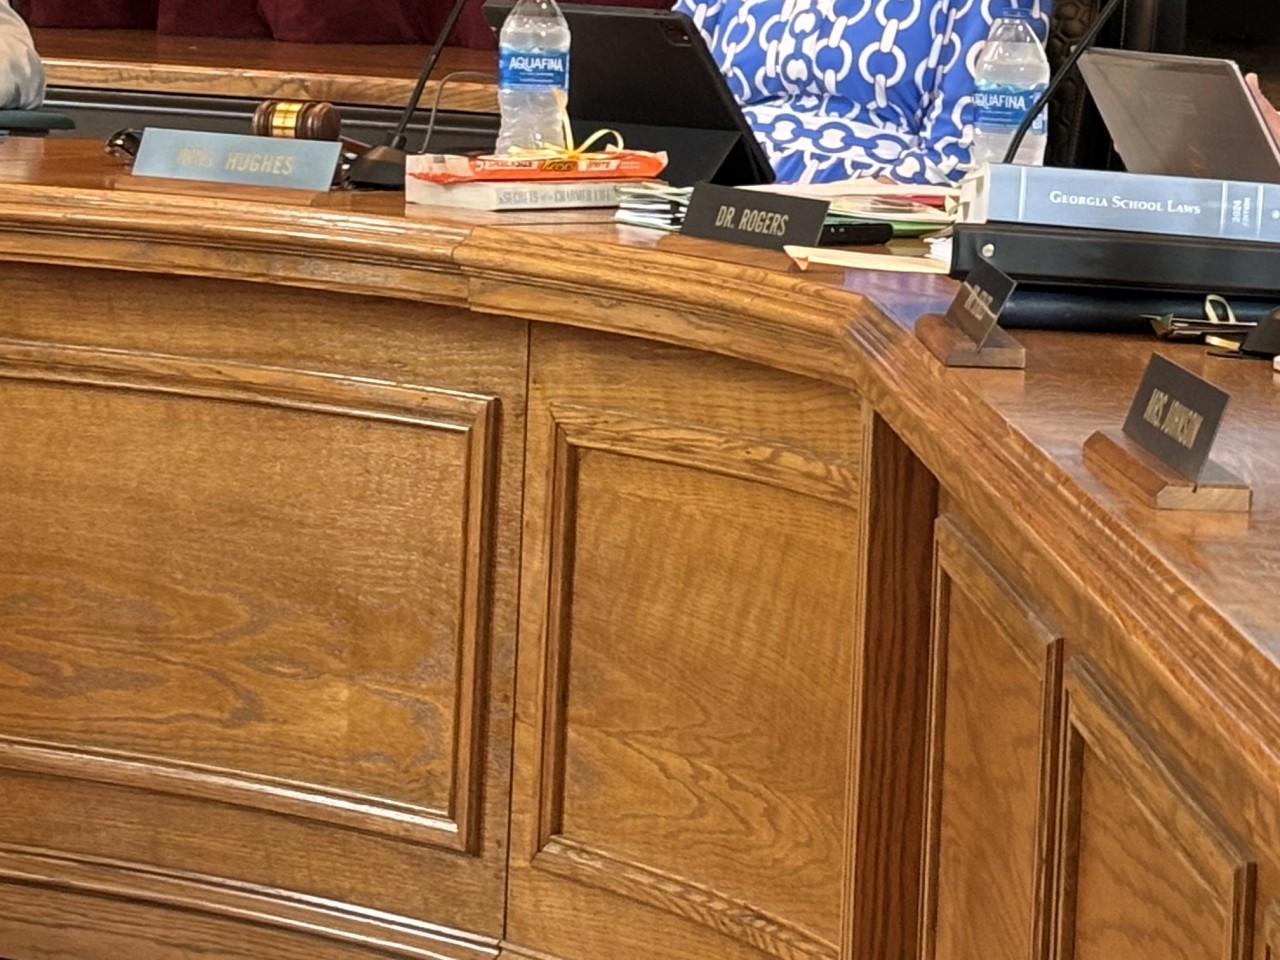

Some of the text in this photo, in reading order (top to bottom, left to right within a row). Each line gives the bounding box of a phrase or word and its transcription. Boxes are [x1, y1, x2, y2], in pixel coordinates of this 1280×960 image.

[508, 56, 564, 72] AQUAFINA
[224, 150, 297, 177] HUGHES
[1049, 190, 1201, 216] GEORGIA SCHOOL LAWS
[1231, 200, 1243, 224] 2024
[715, 205, 789, 237] DR. ROGERS
